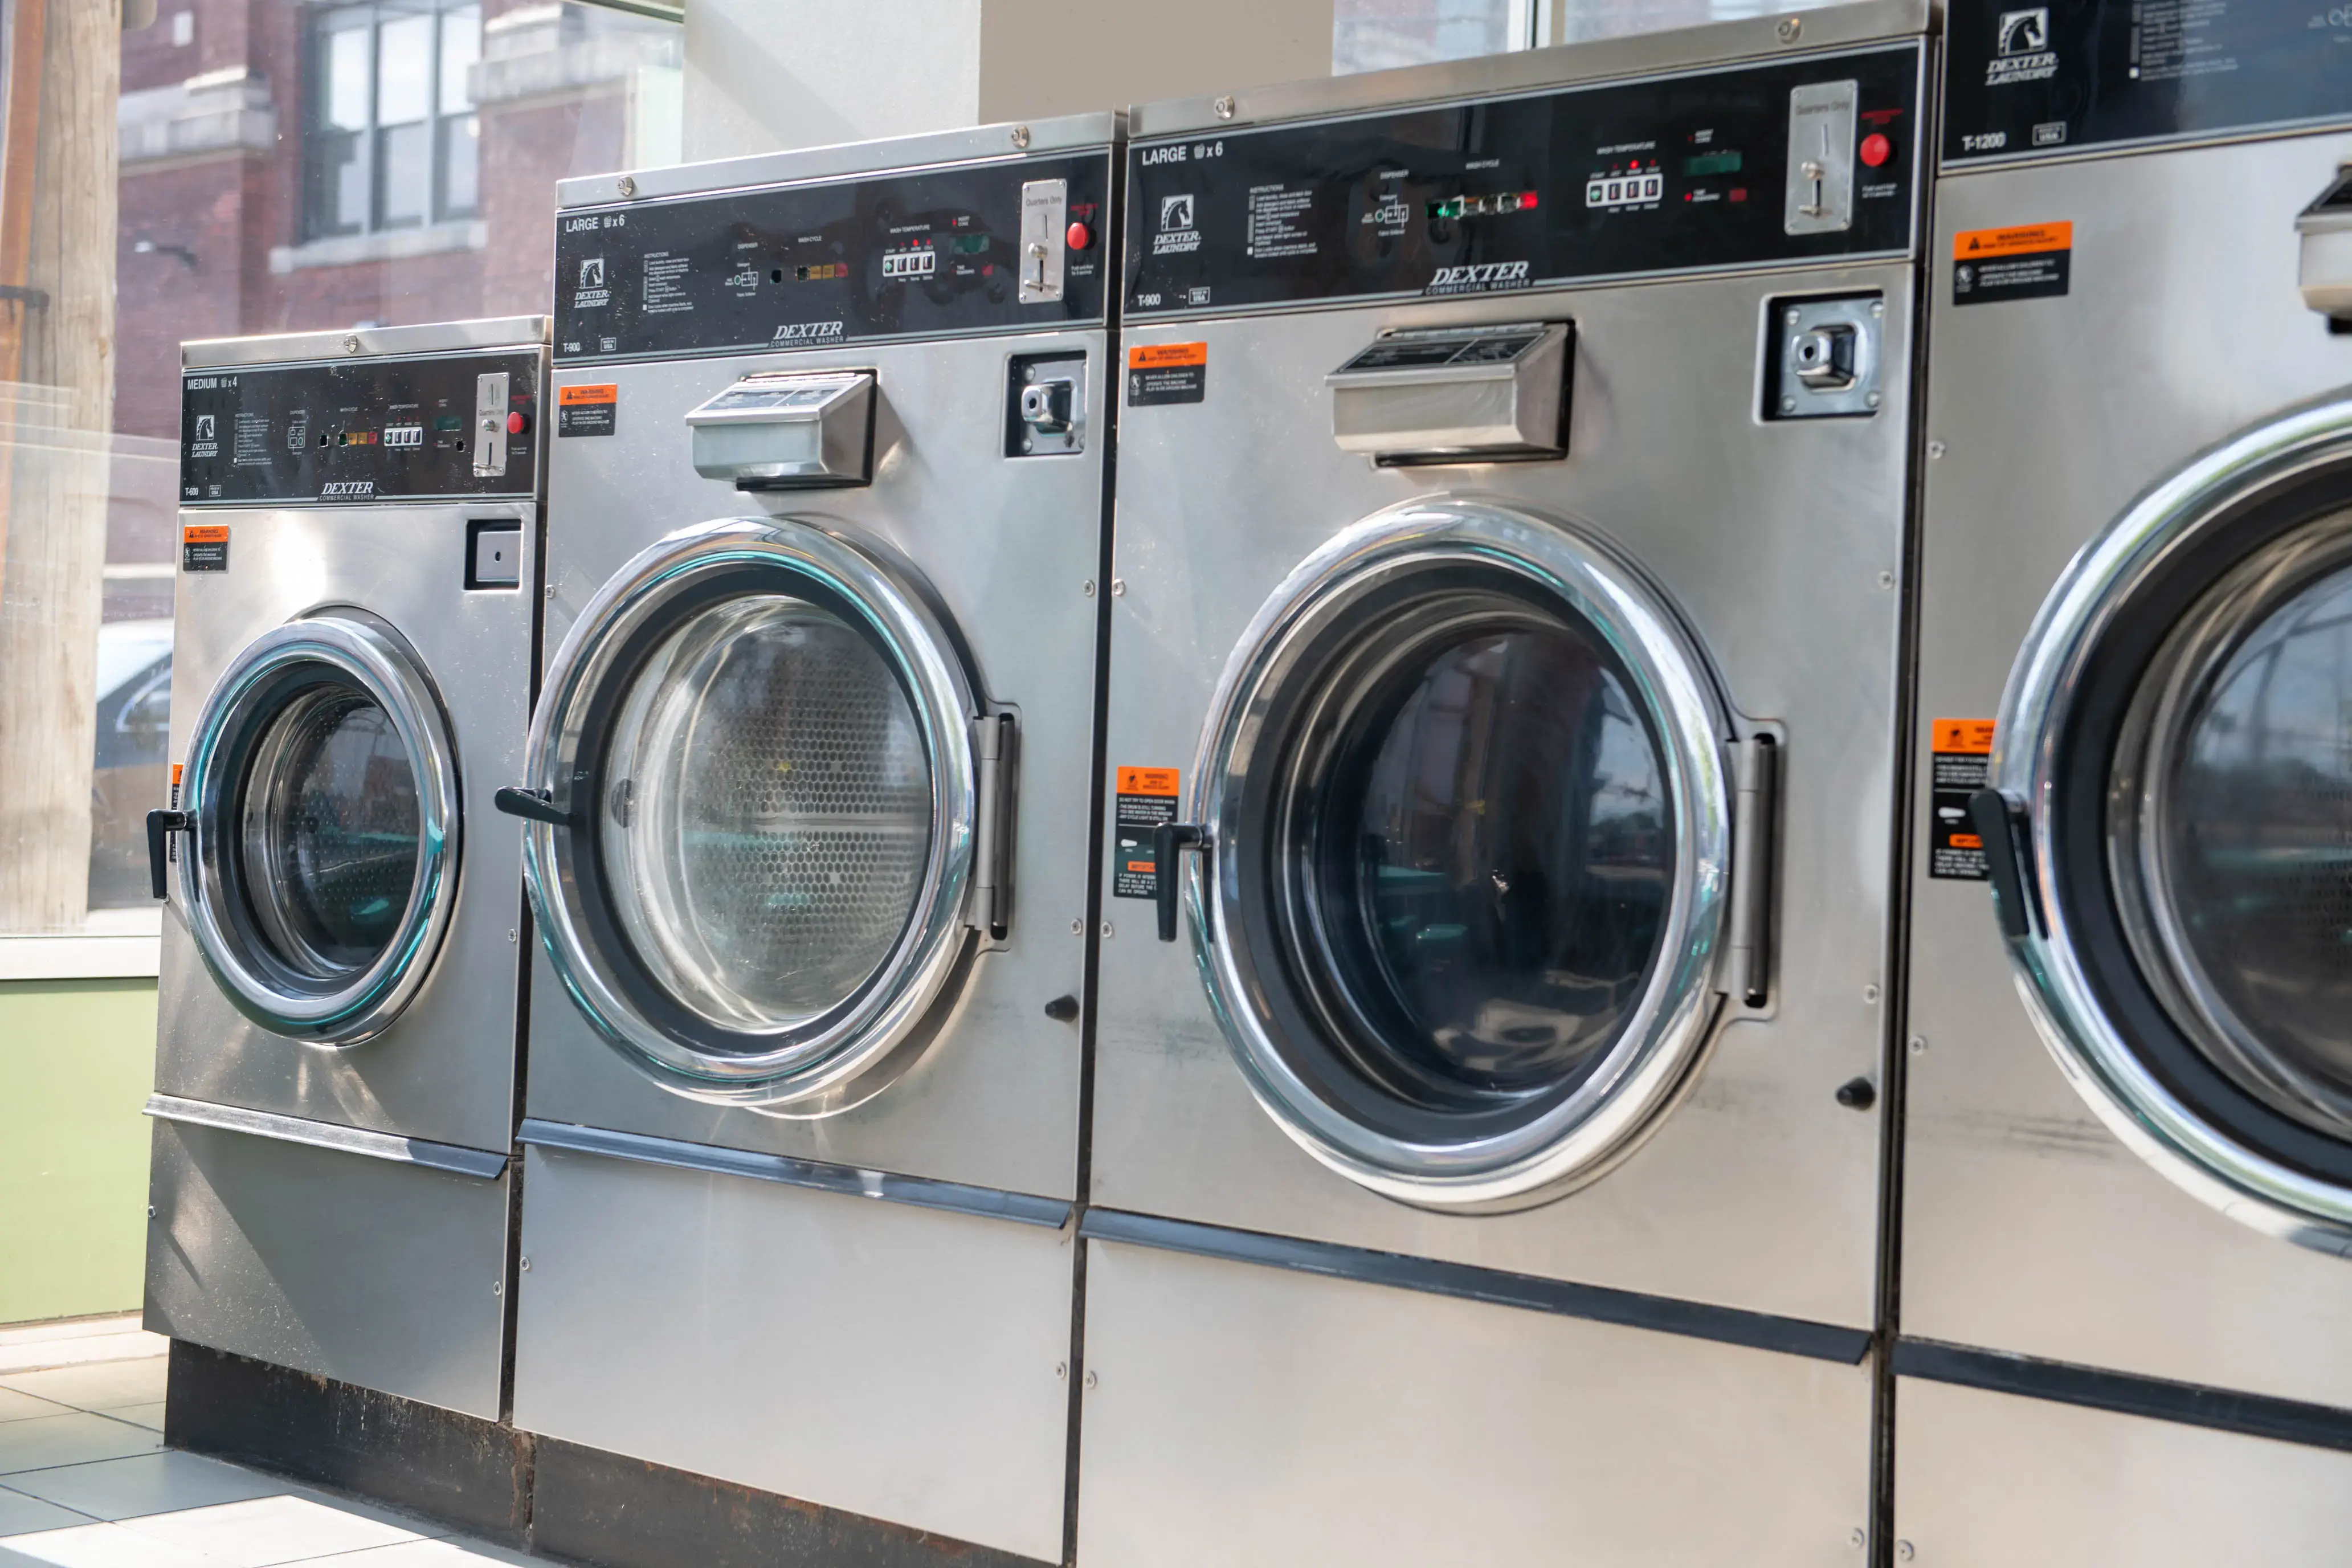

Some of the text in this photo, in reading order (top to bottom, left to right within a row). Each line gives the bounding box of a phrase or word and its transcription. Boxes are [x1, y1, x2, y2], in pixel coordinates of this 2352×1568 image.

[1986, 52, 2056, 74] DEXTER
[1985, 66, 2058, 85] LAUNDRY
[1962, 132, 2006, 151] T-1200
[1142, 141, 1223, 166] LARGE x 6
[1050, 196, 1062, 205] Only
[566, 217, 598, 232] LARGE
[619, 215, 625, 226] 6
[1154, 230, 1199, 245] DEXTER
[1153, 242, 1200, 255] LAUNDRY
[1430, 260, 1529, 286] DEXTER
[1426, 279, 1530, 295] COMMERCIAL WASHER
[574, 290, 607, 300] DEXTER
[1138, 293, 1161, 307] T-900
[574, 299, 609, 308] LAUNDRY
[773, 321, 843, 340] DEXTER
[563, 342, 580, 352] T-900
[770, 338, 814, 348] COMMERCIAL
[187, 378, 217, 390] MEDIUM
[232, 377, 237, 387] 4
[185, 487, 199, 496] T-600
[321, 482, 373, 495] DEXTER
